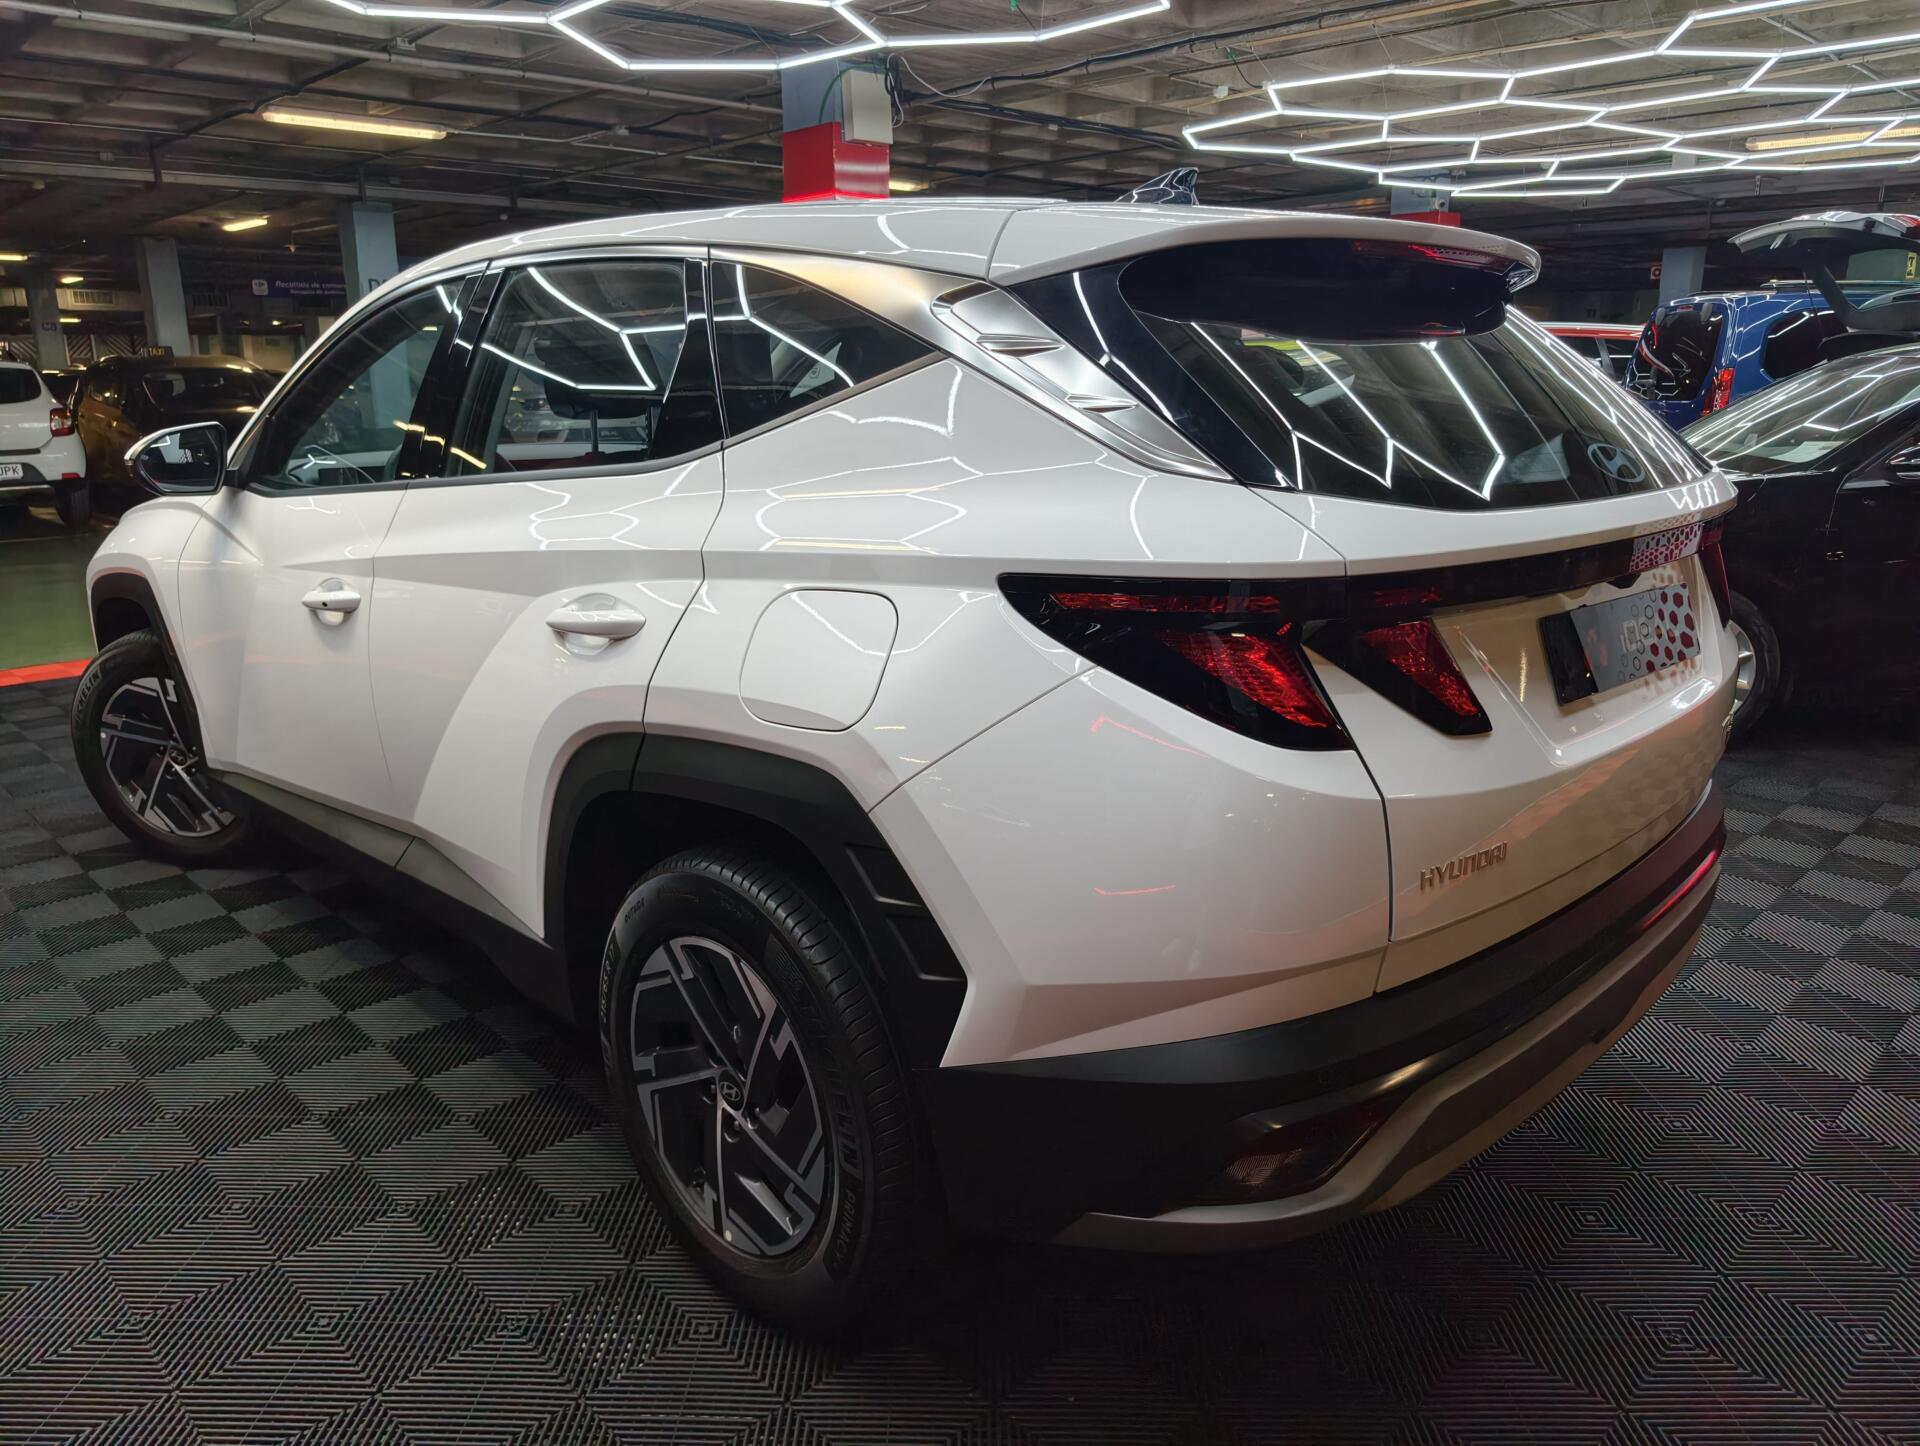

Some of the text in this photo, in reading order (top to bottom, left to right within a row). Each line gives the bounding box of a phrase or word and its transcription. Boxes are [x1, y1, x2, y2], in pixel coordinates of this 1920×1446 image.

[149, 347, 165, 356] TAXI
[1420, 841, 1507, 890] HYUNDAI
[833, 1188, 857, 1261] PRIMACY
